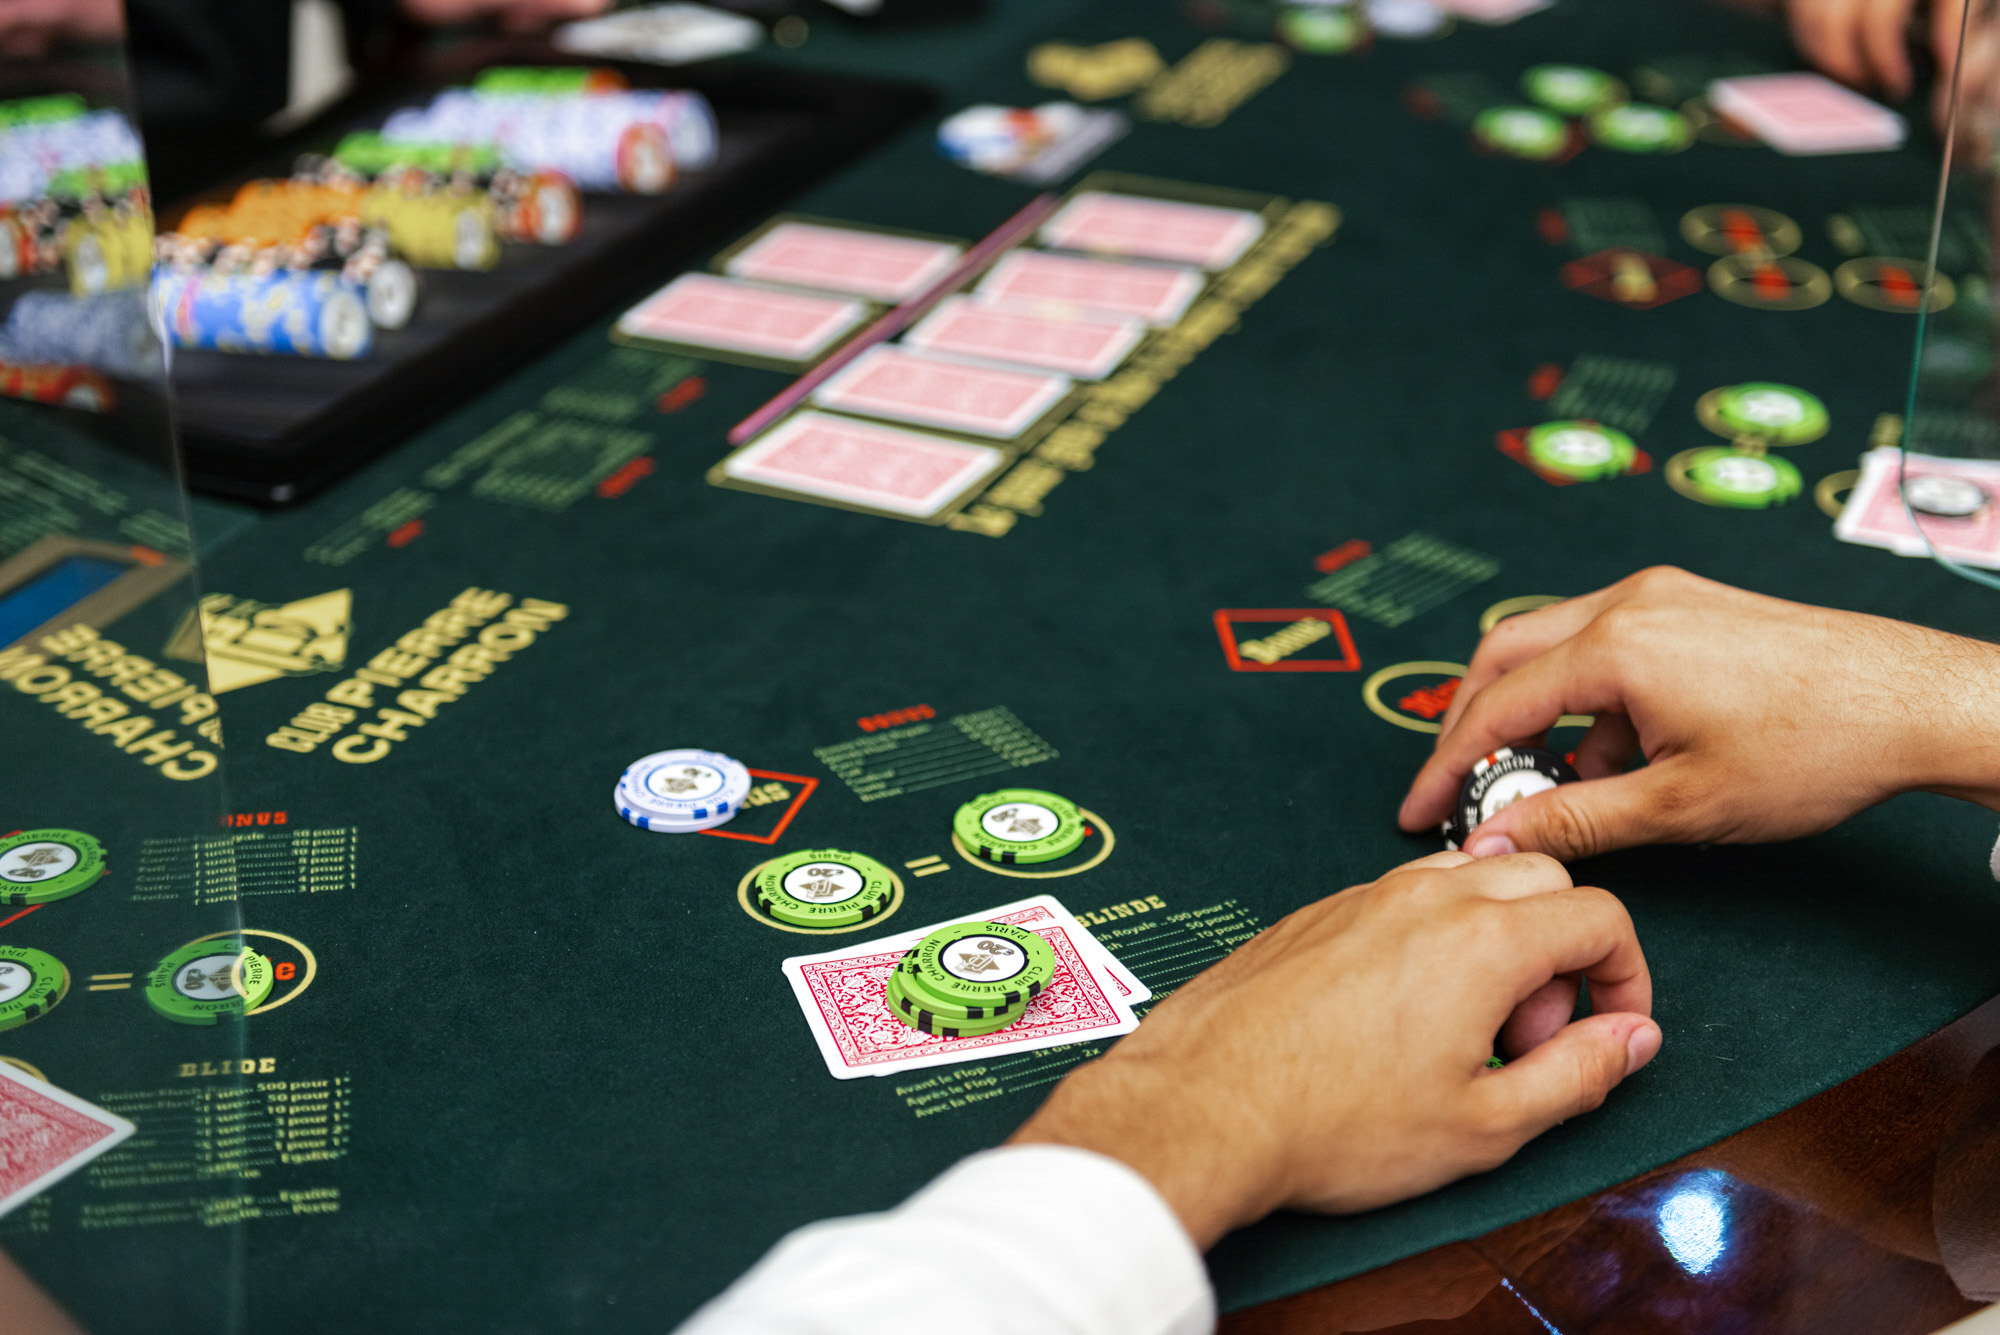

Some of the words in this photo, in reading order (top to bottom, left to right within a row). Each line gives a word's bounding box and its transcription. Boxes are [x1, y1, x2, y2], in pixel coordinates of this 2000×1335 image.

[325, 586, 513, 708] PIERRE
[332, 598, 569, 764] CHARRON
[0, 884, 33, 892] ARIS
[764, 874, 799, 910] CHARRON
[862, 880, 882, 901] CLUB
[808, 902, 860, 914] PIERRE
[1112, 921, 1159, 939] Royale
[1166, 910, 1193, 924] 500
[1193, 903, 1223, 919] pour
[1185, 918, 1205, 930] 50
[1206, 912, 1236, 928] pour
[1196, 928, 1214, 939] 10
[1215, 922, 1245, 937] pour
[985, 925, 1028, 941] PARIS
[1213, 938, 1225, 947] 3
[245, 955, 264, 985] PIERRE
[921, 939, 946, 981] CHARRON
[1014, 966, 1043, 986] CLUB
[951, 982, 1007, 993] PIERRE
[257, 1081, 287, 1092] 500
[290, 1079, 329, 1091] pour
[896, 1078, 938, 1096] Avant
[937, 1075, 953, 1085] le
[953, 1065, 987, 1081] Flop
[948, 1085, 964, 1095] le
[964, 1076, 998, 1092] Flop
[915, 1103, 950, 1119] Avec
[965, 1087, 1004, 1103] River
